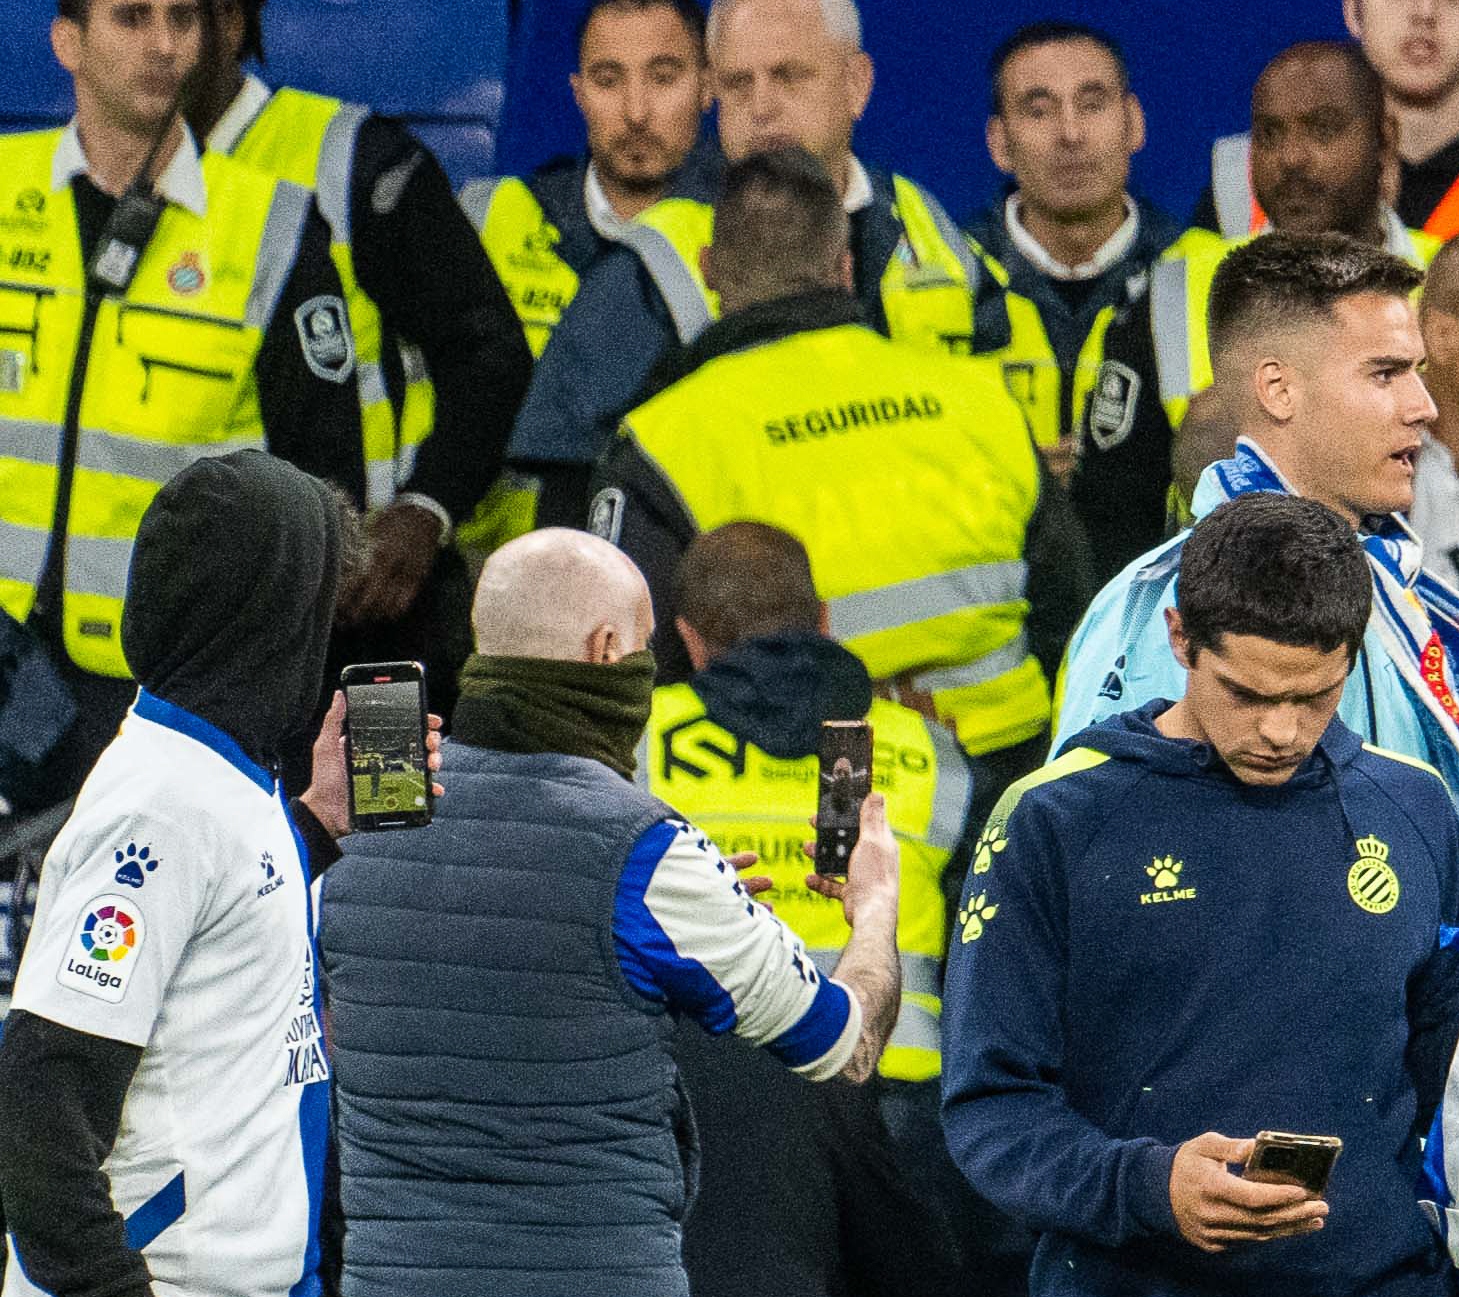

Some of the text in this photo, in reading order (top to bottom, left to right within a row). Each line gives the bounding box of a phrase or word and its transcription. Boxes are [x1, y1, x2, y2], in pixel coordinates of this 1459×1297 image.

[764, 393, 944, 447] SEGURIDAD
[1140, 888, 1197, 905] KELME
[67, 958, 123, 990] LaLiga
